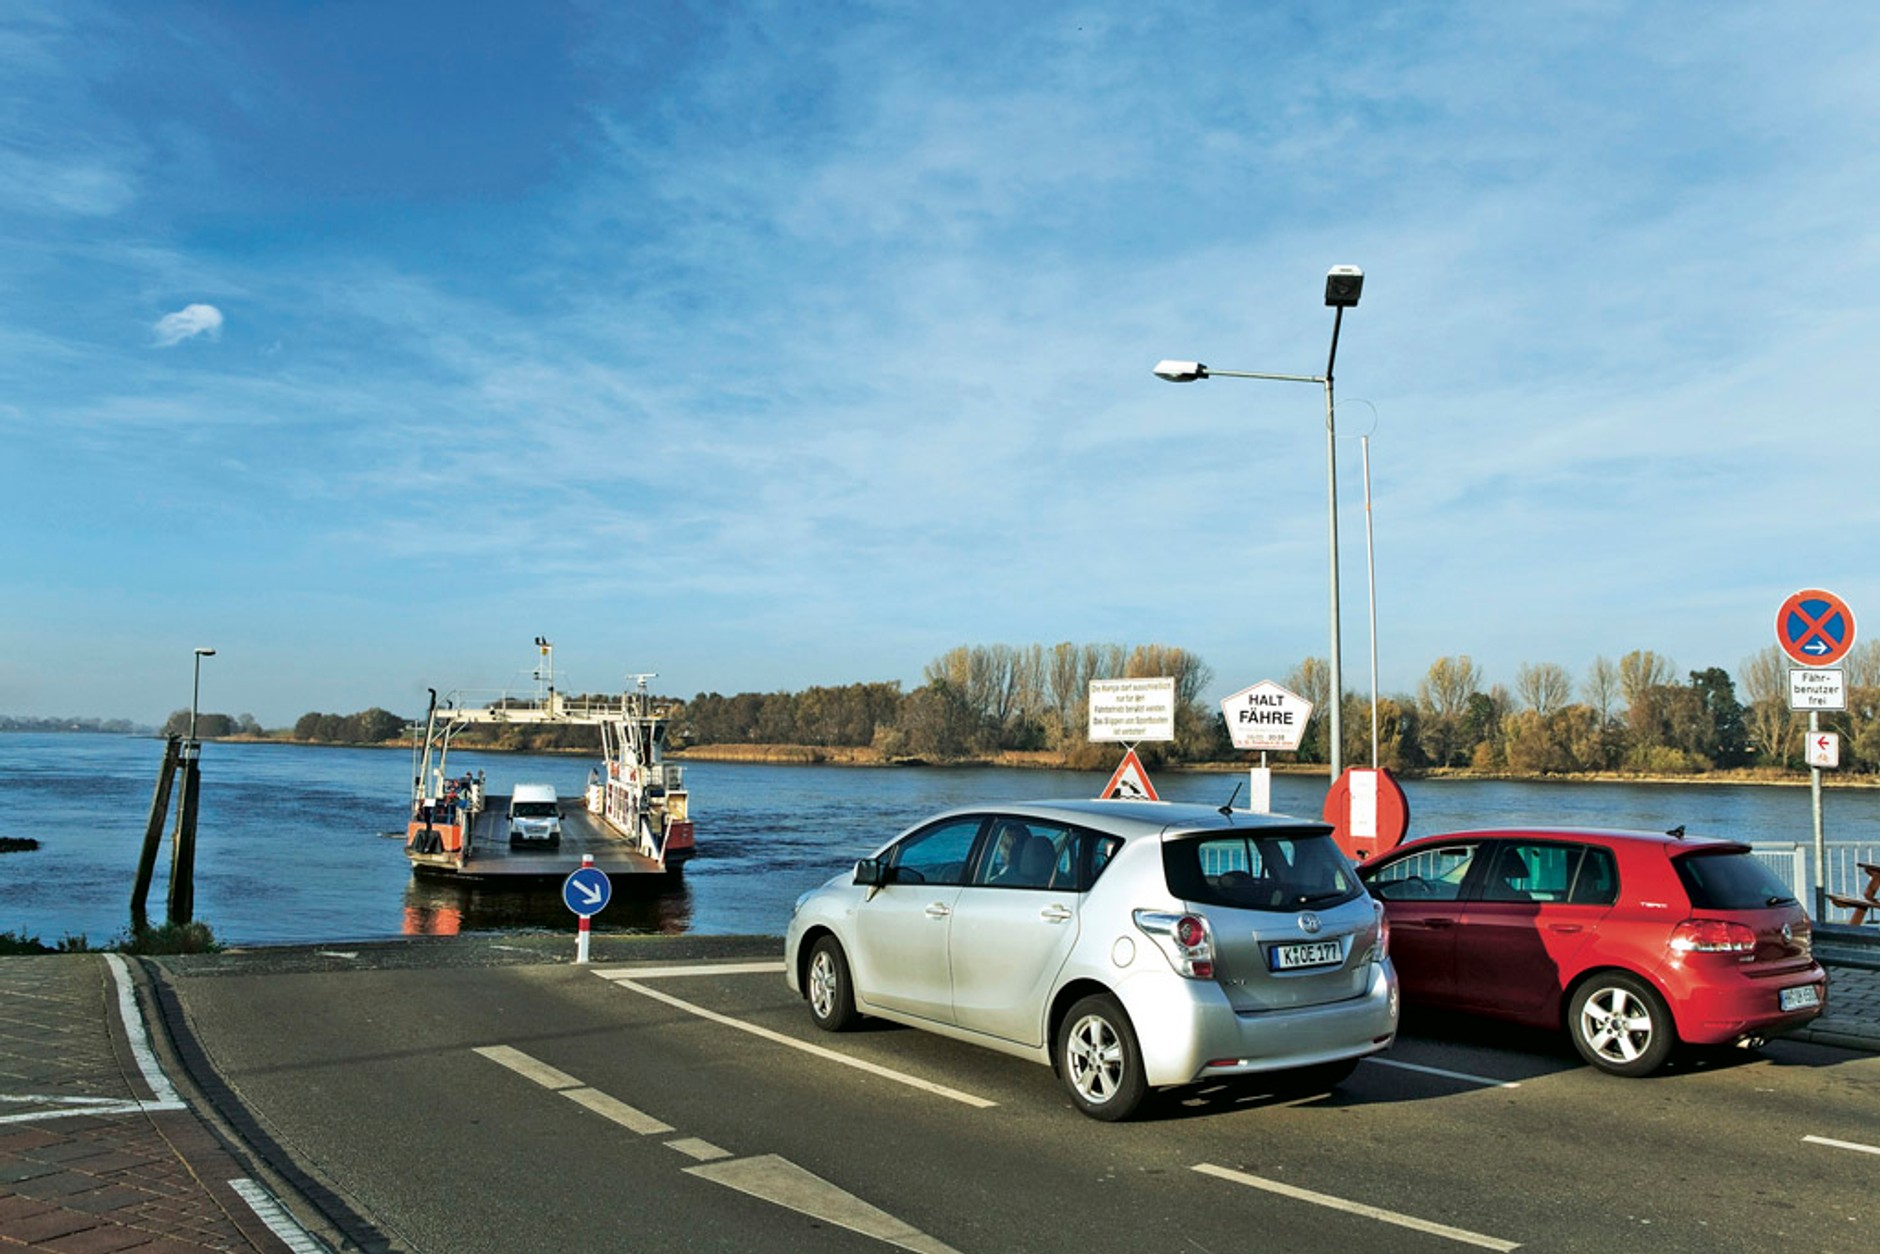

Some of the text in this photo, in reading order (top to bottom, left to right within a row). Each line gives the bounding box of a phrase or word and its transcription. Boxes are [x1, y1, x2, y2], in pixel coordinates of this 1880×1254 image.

[1803, 672, 1831, 682] Fähr-
[1794, 685, 1840, 694] benutzer
[1248, 694, 1284, 706] HALT
[1808, 696, 1827, 705] frei
[1239, 707, 1294, 724] FÄHRE
[1317, 943, 1337, 961] 177
